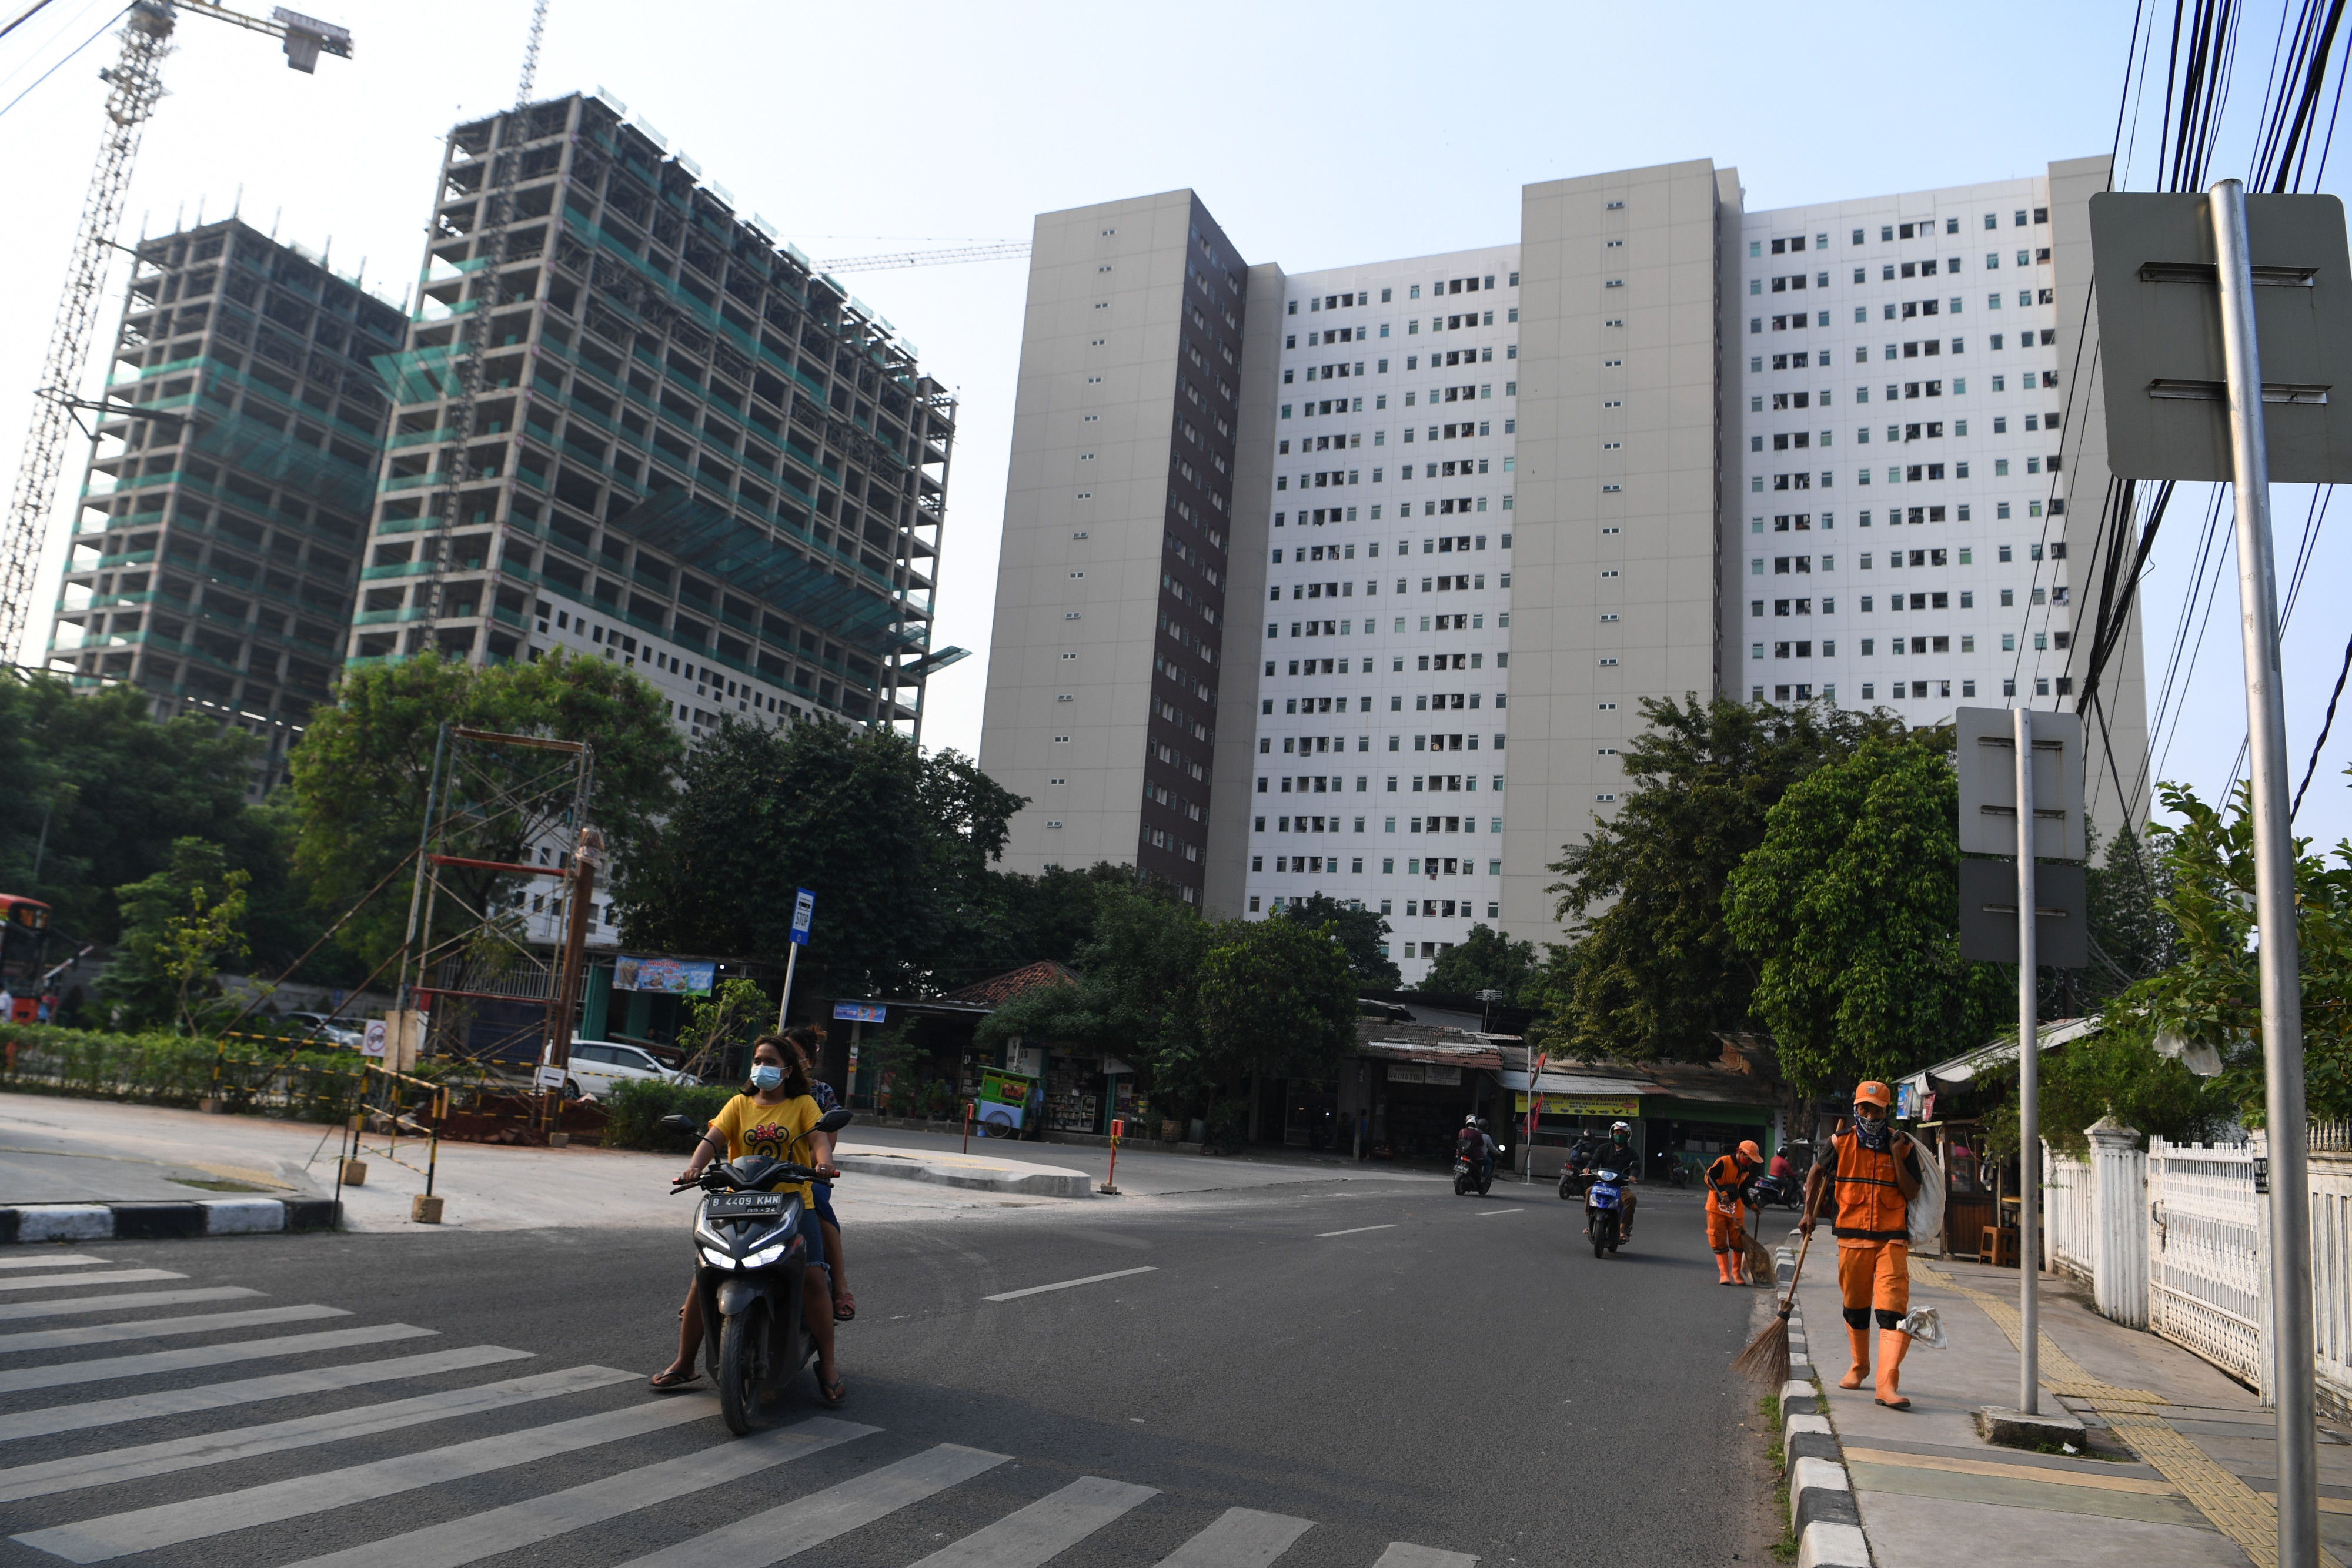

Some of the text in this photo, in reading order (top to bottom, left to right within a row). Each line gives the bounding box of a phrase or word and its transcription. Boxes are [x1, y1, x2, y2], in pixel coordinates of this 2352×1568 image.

[795, 912, 809, 927] STOP
[647, 959, 664, 967] Good
[666, 959, 680, 969] Day
[1389, 1072, 1422, 1081] RADIATOR
[712, 1196, 779, 1206] B 4409 KMN
